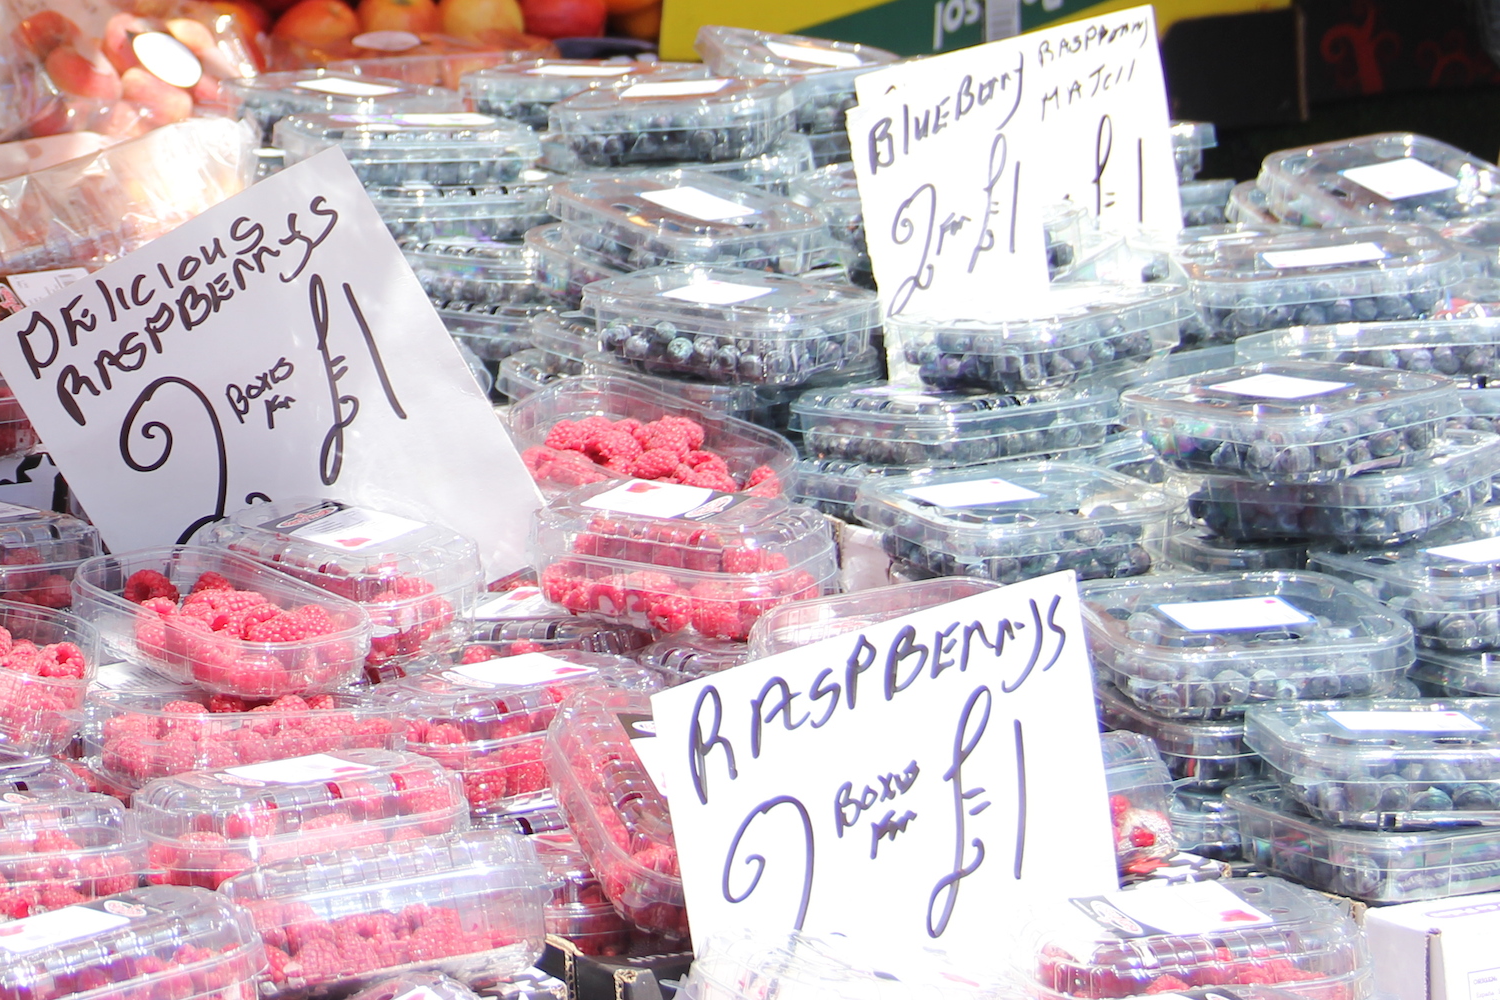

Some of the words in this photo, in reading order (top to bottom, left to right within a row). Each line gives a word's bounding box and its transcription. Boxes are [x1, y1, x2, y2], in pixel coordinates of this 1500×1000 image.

[966, 132, 1021, 275] £1
[309, 272, 407, 486] £1
[687, 594, 1067, 806] RASPBERRYS
[926, 684, 1027, 939] £1
